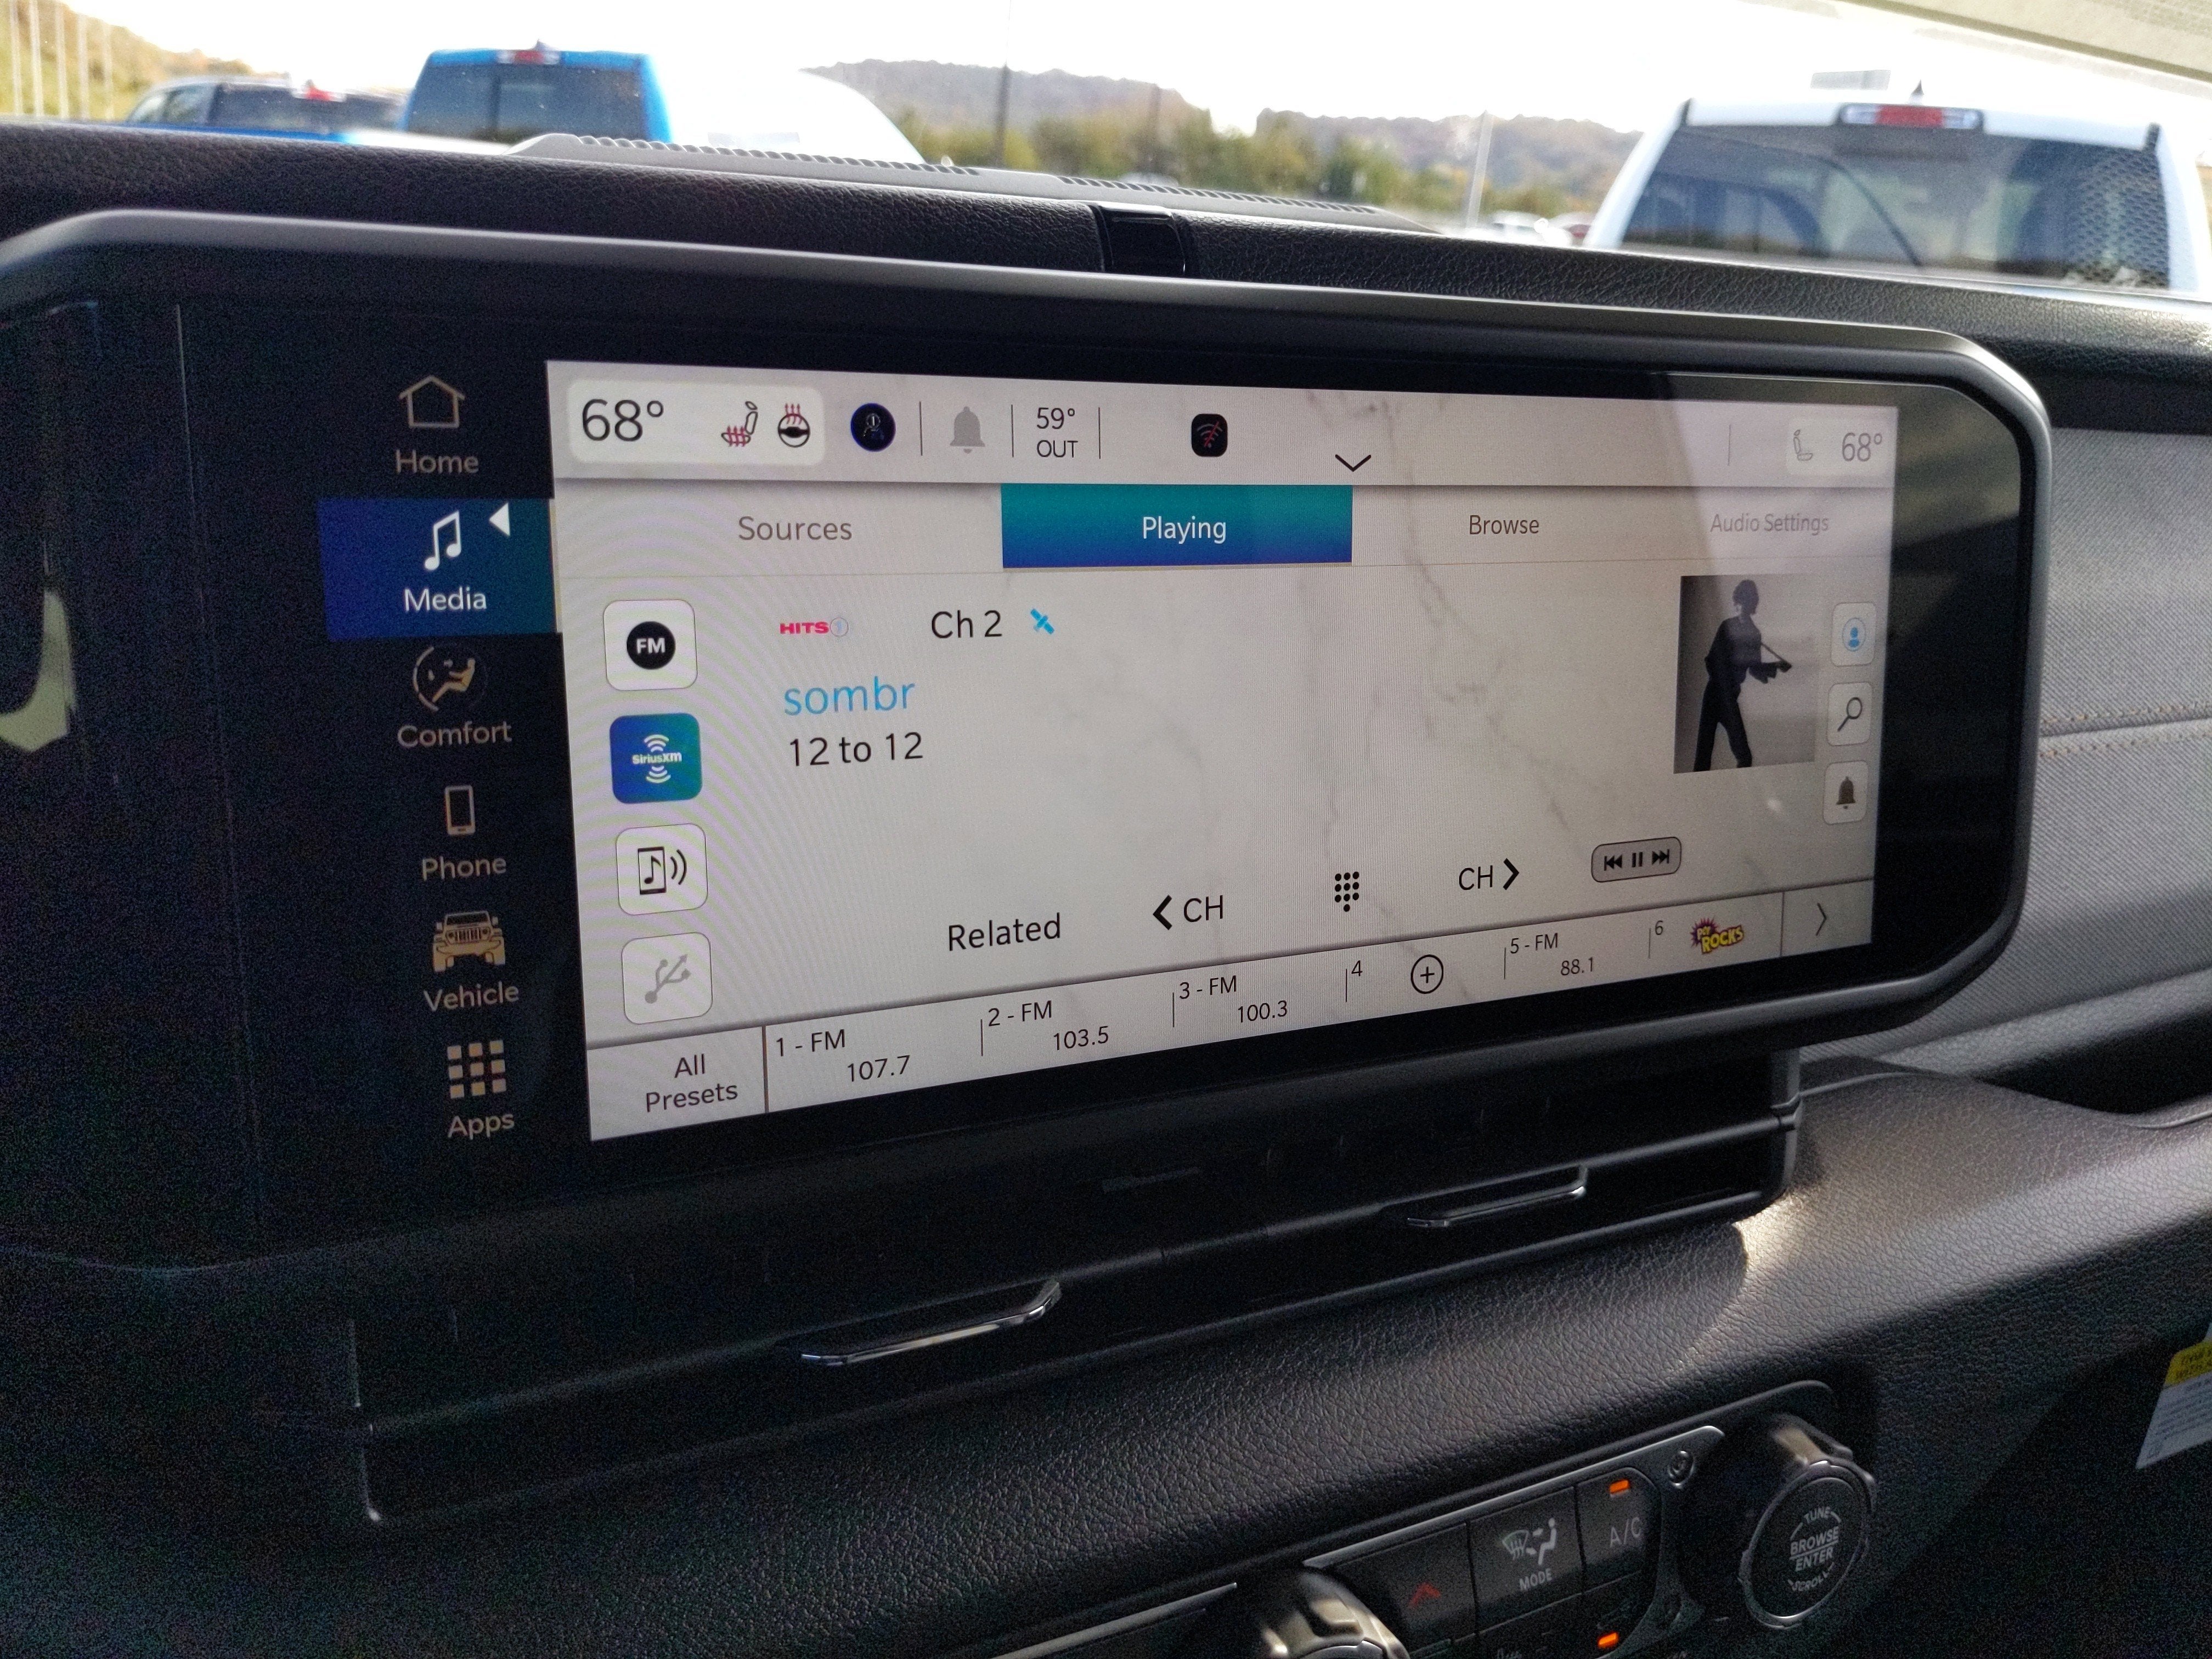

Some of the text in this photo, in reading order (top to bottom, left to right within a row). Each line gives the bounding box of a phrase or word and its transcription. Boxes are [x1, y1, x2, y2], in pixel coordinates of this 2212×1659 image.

[1037, 439, 1078, 458] OUT
[396, 450, 479, 474] Home
[738, 516, 852, 541] Sources
[1143, 516, 1226, 544] Playing
[1469, 515, 1539, 535] Browse
[1710, 514, 1829, 536] Audio Settings
[404, 587, 487, 612] Media
[932, 610, 1003, 639] Ch 2
[636, 637, 665, 653] FM
[784, 676, 916, 715] sombr
[398, 721, 511, 748] Comfort
[789, 732, 923, 766] 12 to 12
[422, 855, 506, 880] Phone
[1459, 865, 1493, 890] CH
[1183, 895, 1224, 922] CH
[949, 912, 1061, 951] Related
[1655, 920, 1663, 935] 6
[1701, 924, 1743, 953] ROCKS
[1510, 938, 1519, 954] 5
[1536, 933, 1558, 951] FM
[1351, 960, 1363, 977] 4
[1561, 957, 1594, 976] 88.1
[424, 981, 519, 1012] Vehicle
[1179, 981, 1190, 999] 3
[1209, 975, 1237, 995] FM
[988, 1008, 1001, 1027] 2
[1022, 1000, 1052, 1023] FM
[1237, 1000, 1288, 1023] 100.3
[776, 1037, 784, 1057] 1
[811, 1029, 845, 1052] FM
[1053, 1026, 1109, 1051] 103.5
[675, 1054, 705, 1078] All
[847, 1055, 910, 1082] 107.7
[646, 1082, 737, 1113] Presets
[448, 1112, 515, 1140] Apps
[1804, 1506, 1831, 1523] TUNE
[1610, 1516, 1642, 1548] A/C
[1790, 1526, 1839, 1555] BROWSE
[1796, 1547, 1833, 1572] ENTER
[1520, 1567, 1552, 1592] MODE
